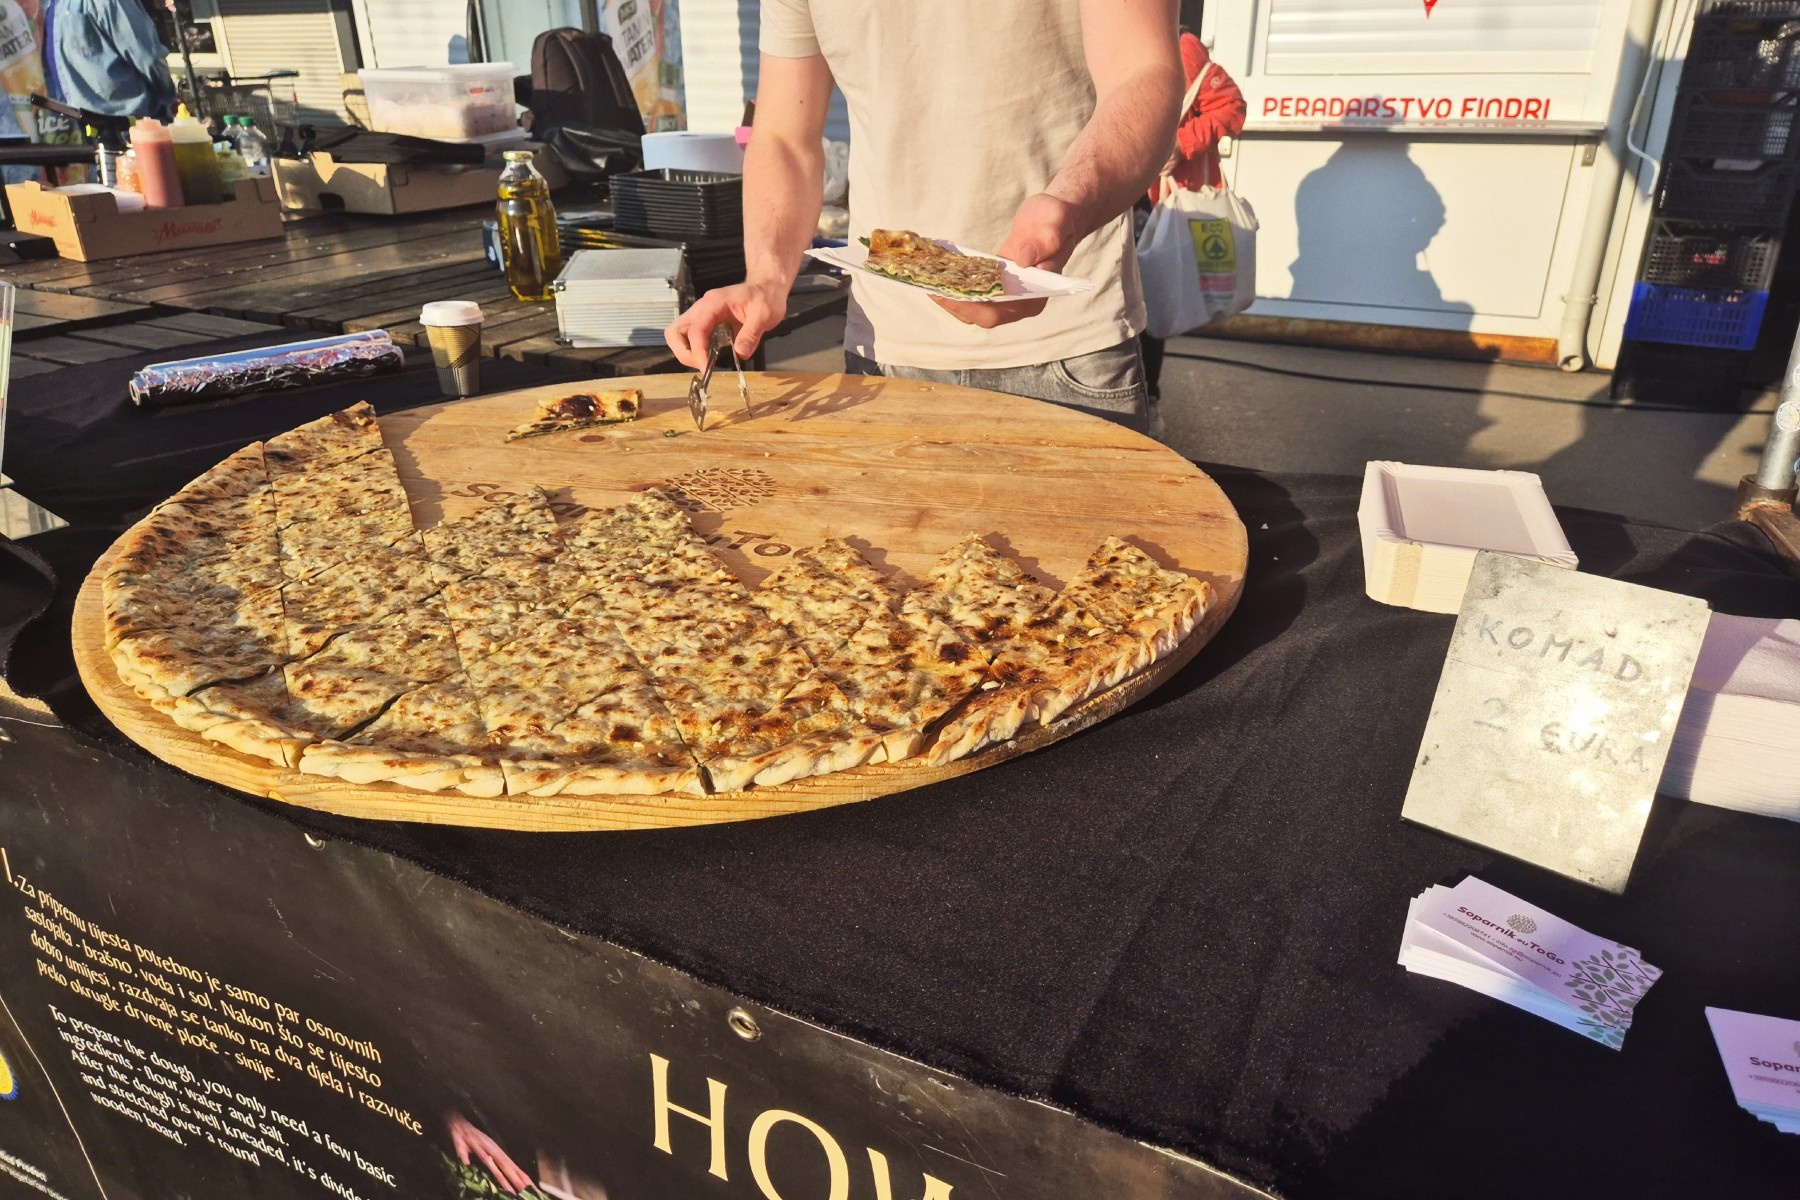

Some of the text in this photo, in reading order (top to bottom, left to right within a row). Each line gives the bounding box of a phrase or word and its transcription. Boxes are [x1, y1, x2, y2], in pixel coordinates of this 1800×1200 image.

[1262, 97, 1551, 120] PERADARSTVO FINDRI
[1477, 614, 1644, 683] KOMAD
[17, 875, 36, 898] Za
[38, 890, 87, 932] pripremu
[88, 922, 132, 952] tijesta
[134, 944, 203, 983] potrebno
[204, 972, 221, 994] je
[225, 984, 271, 1010] samo
[274, 1002, 300, 1024] par
[306, 1018, 382, 1063] osnovnih
[25, 905, 73, 947] sastojaka
[140, 968, 176, 996] voda
[177, 984, 186, 999] i
[220, 1000, 275, 1036] Nakon
[277, 1022, 304, 1049] što
[308, 1042, 326, 1060] se
[330, 1051, 382, 1087] tijesto
[37, 958, 68, 986] preko
[70, 979, 122, 1012] okrugle
[124, 1002, 175, 1036] drvene
[176, 1025, 220, 1055] ploče
[31, 929, 63, 963] dobro
[119, 981, 178, 1019] razdvaja
[181, 1010, 201, 1025] se
[203, 1015, 246, 1045] tanko
[250, 1037, 271, 1056] na
[275, 1046, 303, 1071] dva
[307, 1062, 344, 1094] djela
[347, 1082, 355, 1098] i
[359, 1090, 424, 1135] razvuče
[57, 1026, 134, 1071] ingredients
[184, 1087, 223, 1114] water
[228, 1106, 256, 1129] and
[48, 1004, 68, 1023] To
[69, 1017, 123, 1048] prepare
[124, 1039, 148, 1060] the
[202, 1079, 233, 1099] you
[236, 1093, 267, 1119] only
[271, 1109, 310, 1137] need
[312, 1131, 323, 1145] a
[325, 1134, 351, 1162] few
[354, 1151, 398, 1188] basic
[71, 1049, 105, 1073] After
[107, 1064, 130, 1085] the
[133, 1077, 176, 1108] dough
[176, 1098, 192, 1114] is
[193, 1108, 222, 1131] well
[320, 1172, 371, 1200] divid
[80, 1071, 261, 1167] and stretched over a round
[90, 1091, 144, 1123] wooden
